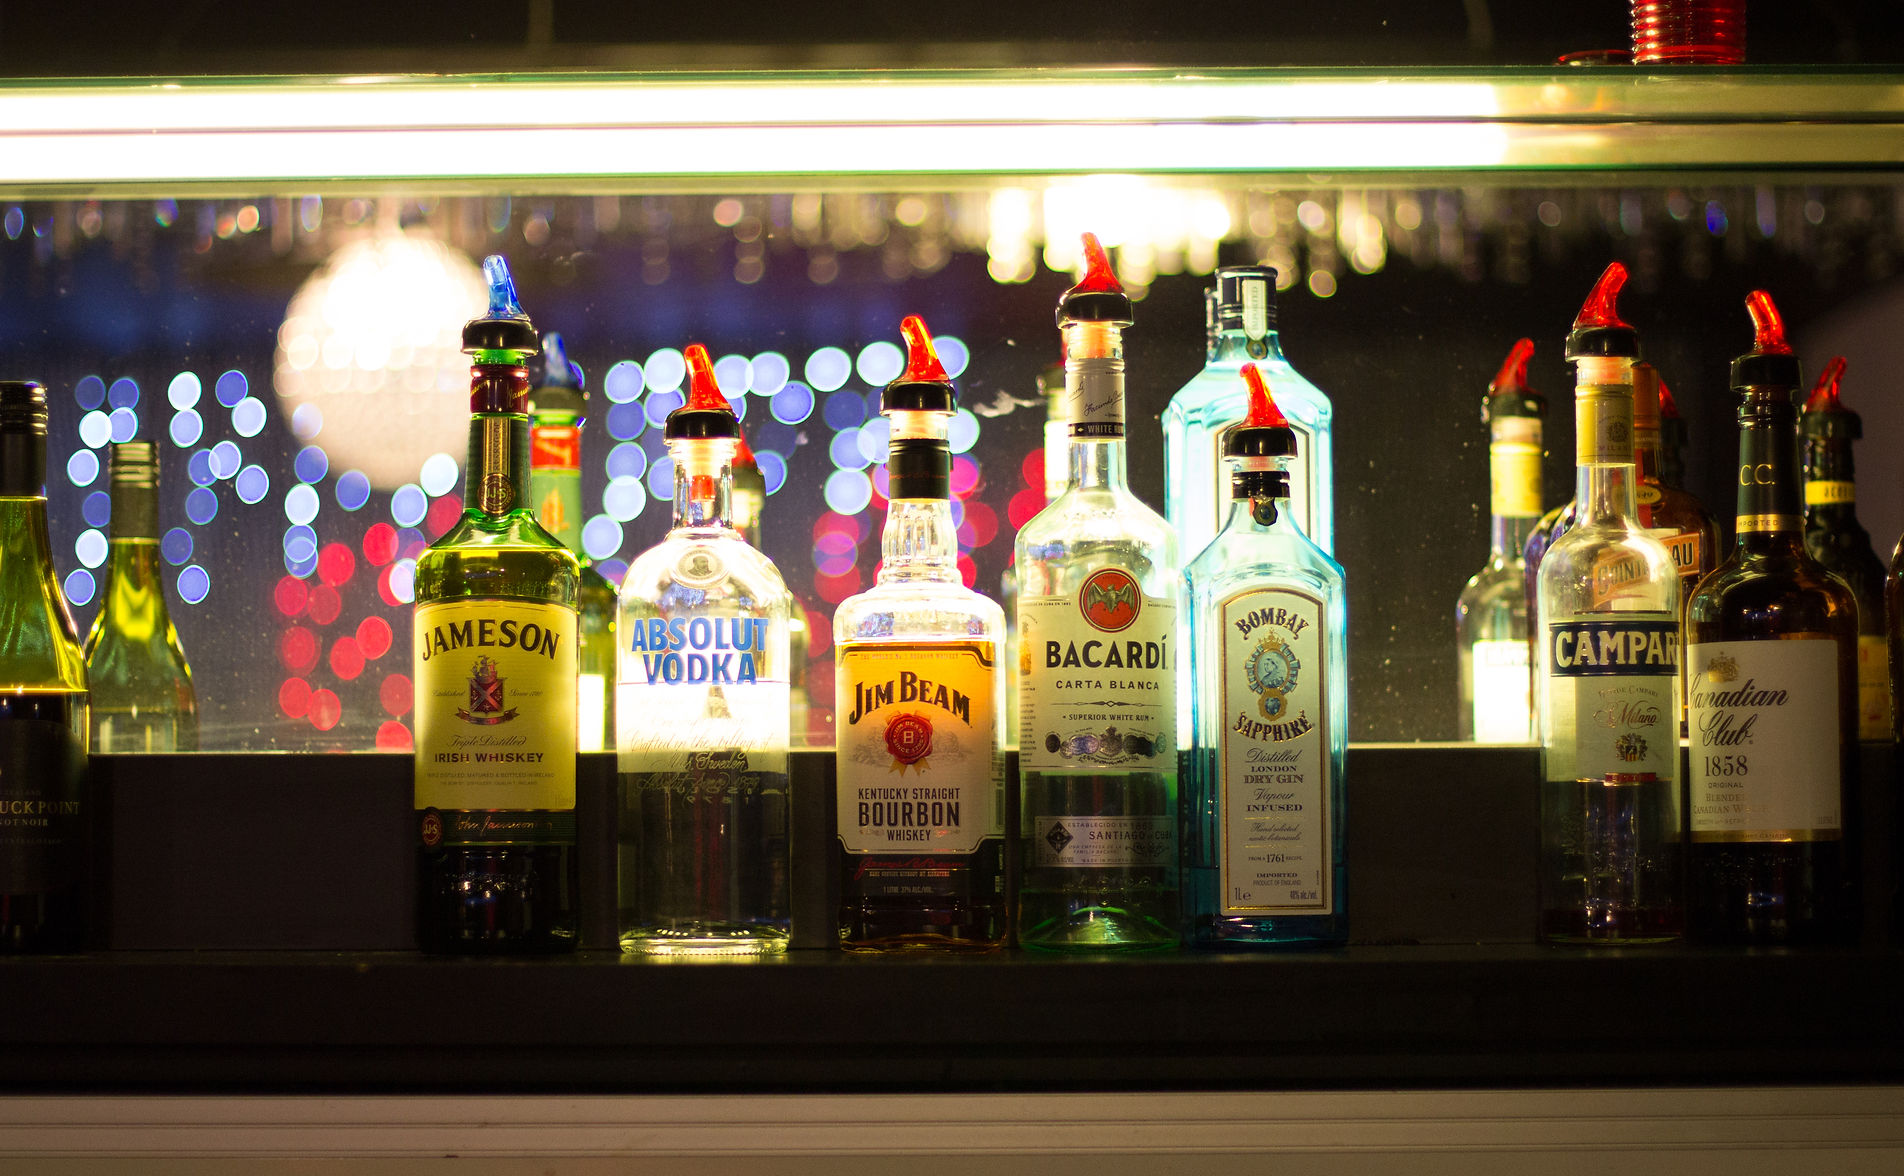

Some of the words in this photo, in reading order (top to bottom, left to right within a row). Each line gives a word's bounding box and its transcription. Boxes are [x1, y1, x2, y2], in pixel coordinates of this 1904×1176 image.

[1088, 425, 1112, 433] WHITE
[1234, 607, 1310, 641] BOMBAY
[422, 619, 561, 661] JAMESON
[632, 617, 769, 652] ABSOLUT
[1046, 634, 1166, 669] BACARDÍ
[643, 652, 757, 685] VODKA
[1056, 680, 1102, 689] CARTA
[1110, 681, 1159, 690] BLANCA
[1690, 673, 1789, 708] Canadian
[849, 680, 895, 725] JIM
[899, 671, 970, 726] BEAM
[1136, 714, 1149, 722] RUM
[1232, 709, 1313, 743] SAPPHIRE
[1699, 710, 1757, 746] Club
[904, 731, 914, 743] B
[435, 753, 469, 763] IRISH
[475, 753, 544, 763] WHISKEY
[1244, 747, 1303, 763] Distilled
[1704, 755, 1748, 777] 1858
[1244, 775, 1273, 784] DRY
[1276, 775, 1304, 784] GIN
[858, 788, 908, 800] KENTUCKY
[912, 788, 961, 800] STRAIGHT
[1253, 788, 1295, 803] Vapour
[38, 800, 80, 816] POINT
[858, 802, 960, 827] BOURBON
[1247, 804, 1303, 812] INFUSED
[887, 829, 931, 841] WHISKEY
[1089, 831, 1146, 840] SANTIAGO
[1267, 854, 1285, 863] 1761
